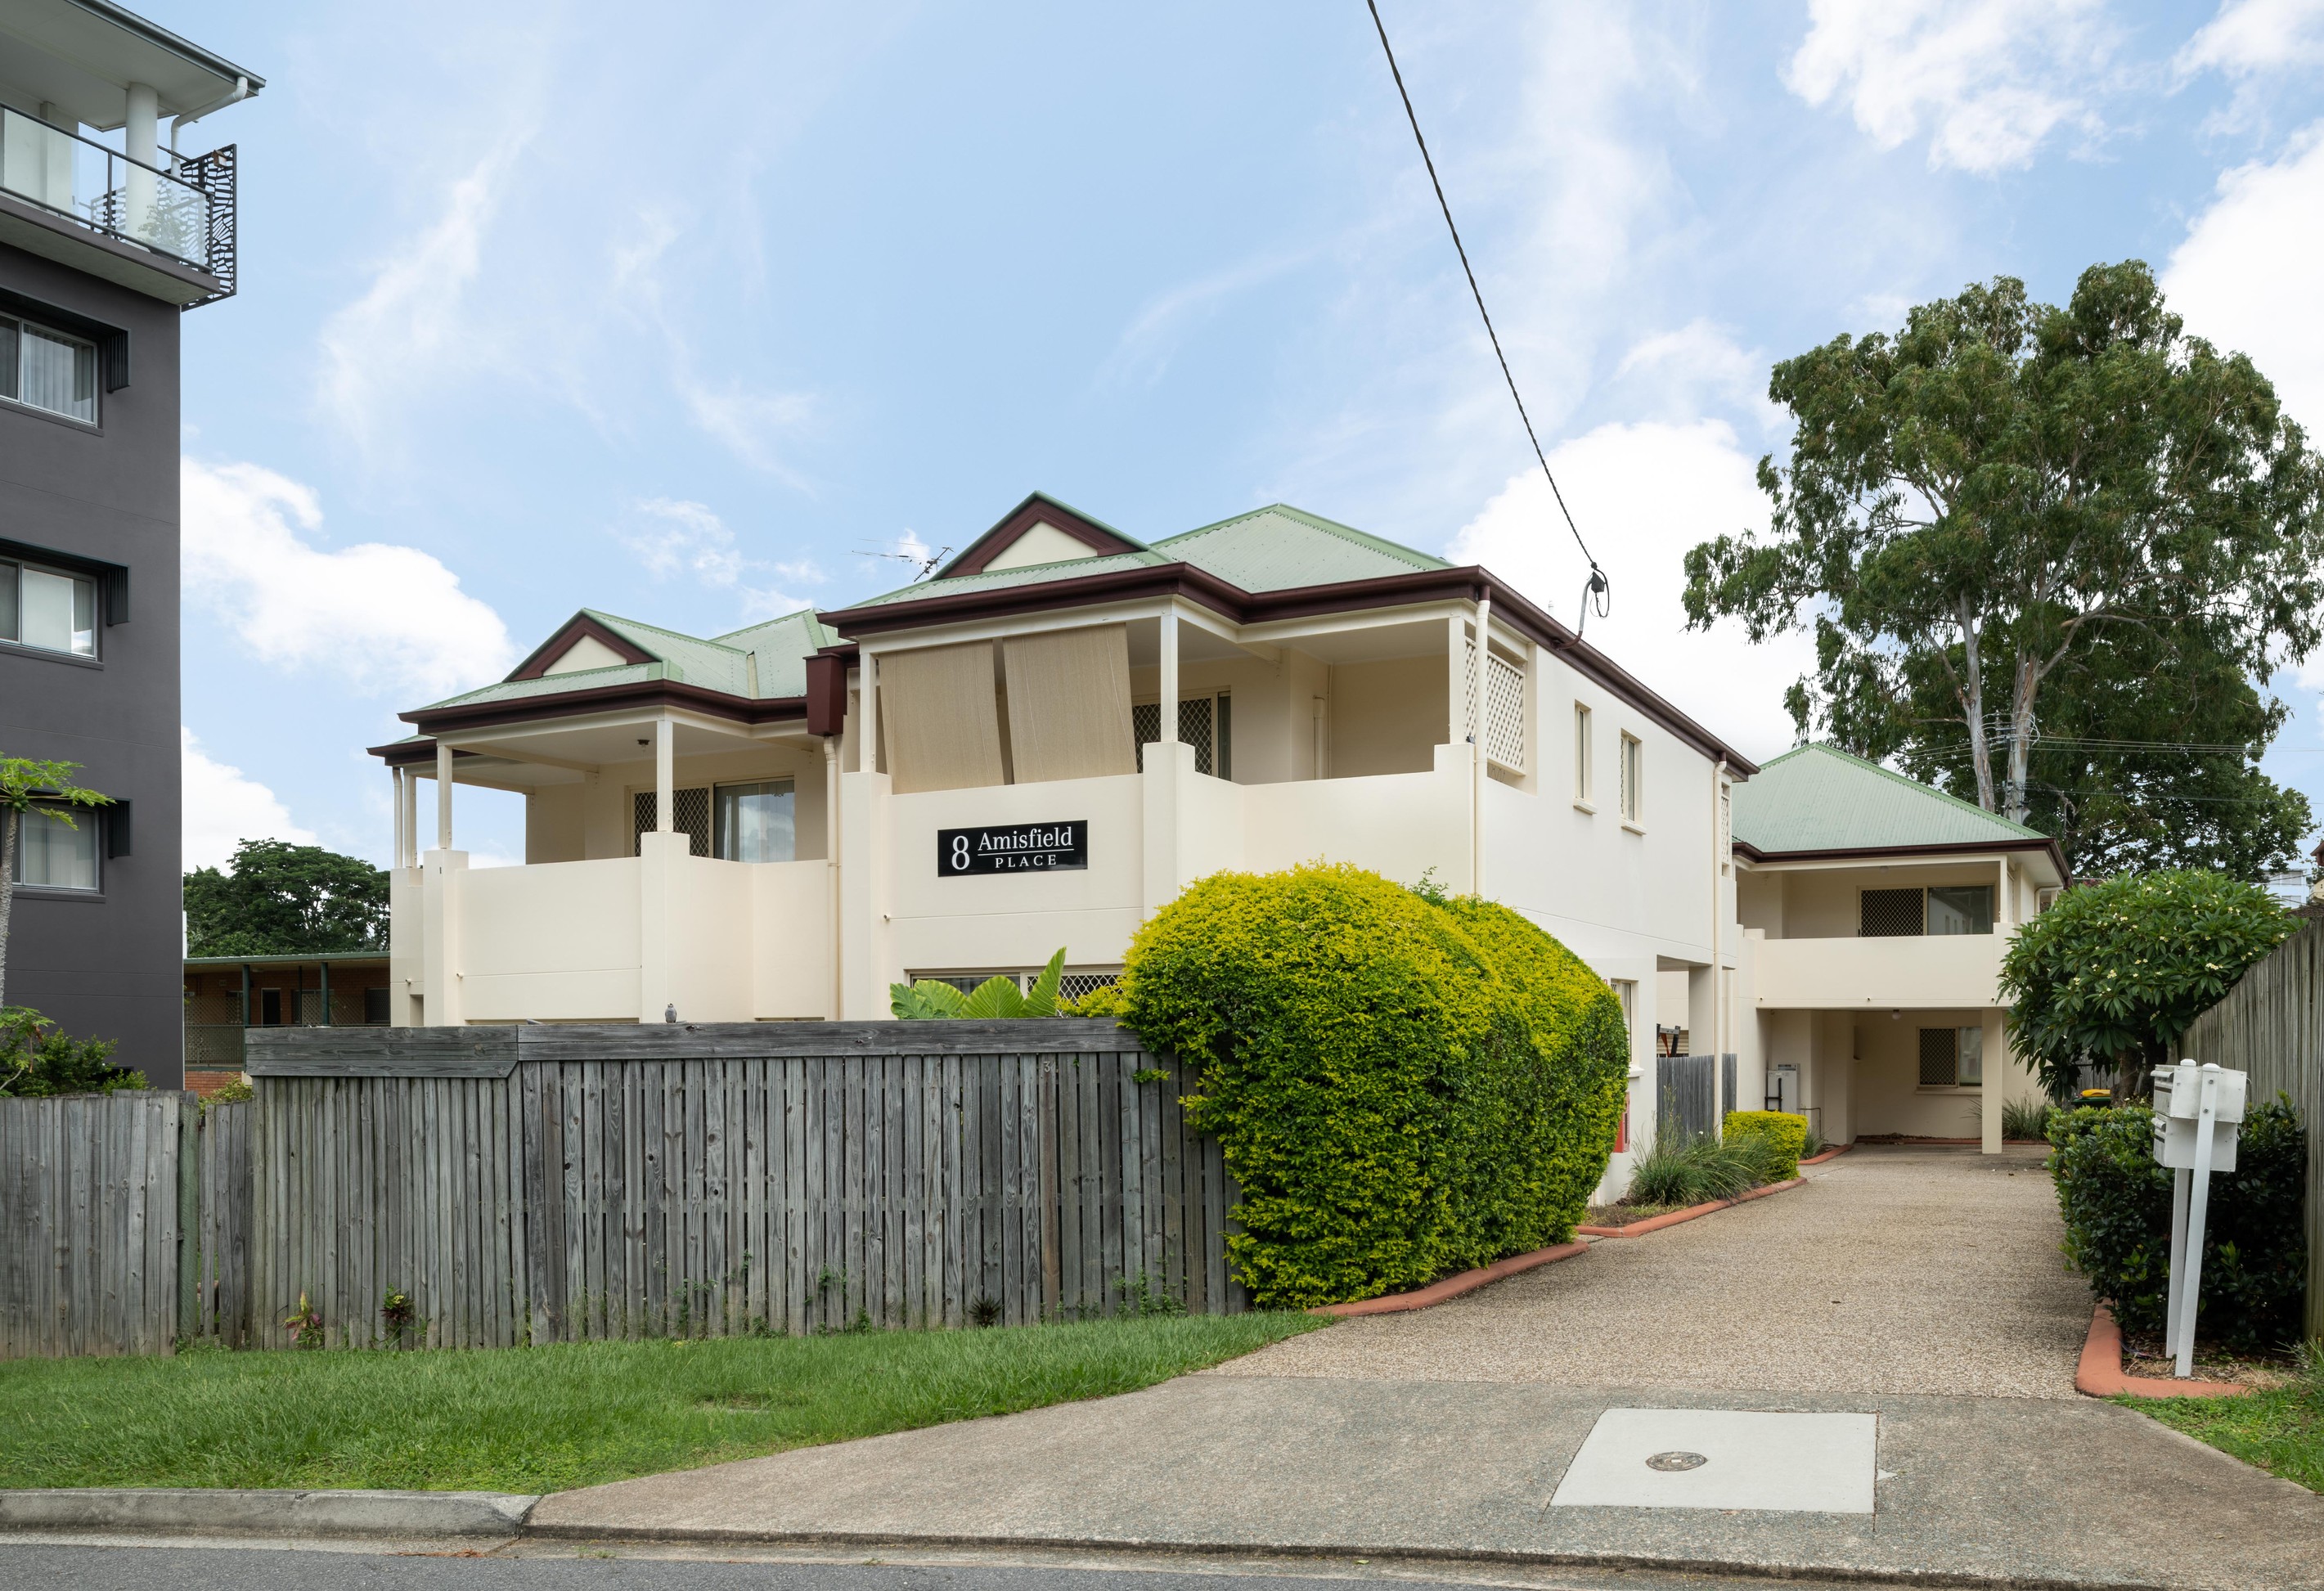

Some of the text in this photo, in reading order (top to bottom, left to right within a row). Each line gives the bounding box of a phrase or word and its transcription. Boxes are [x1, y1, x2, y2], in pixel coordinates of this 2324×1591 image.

[951, 826, 1074, 870] 8 Amisfield
[995, 854, 1057, 869] PLACE
[1043, 1060, 1050, 1073] 3
